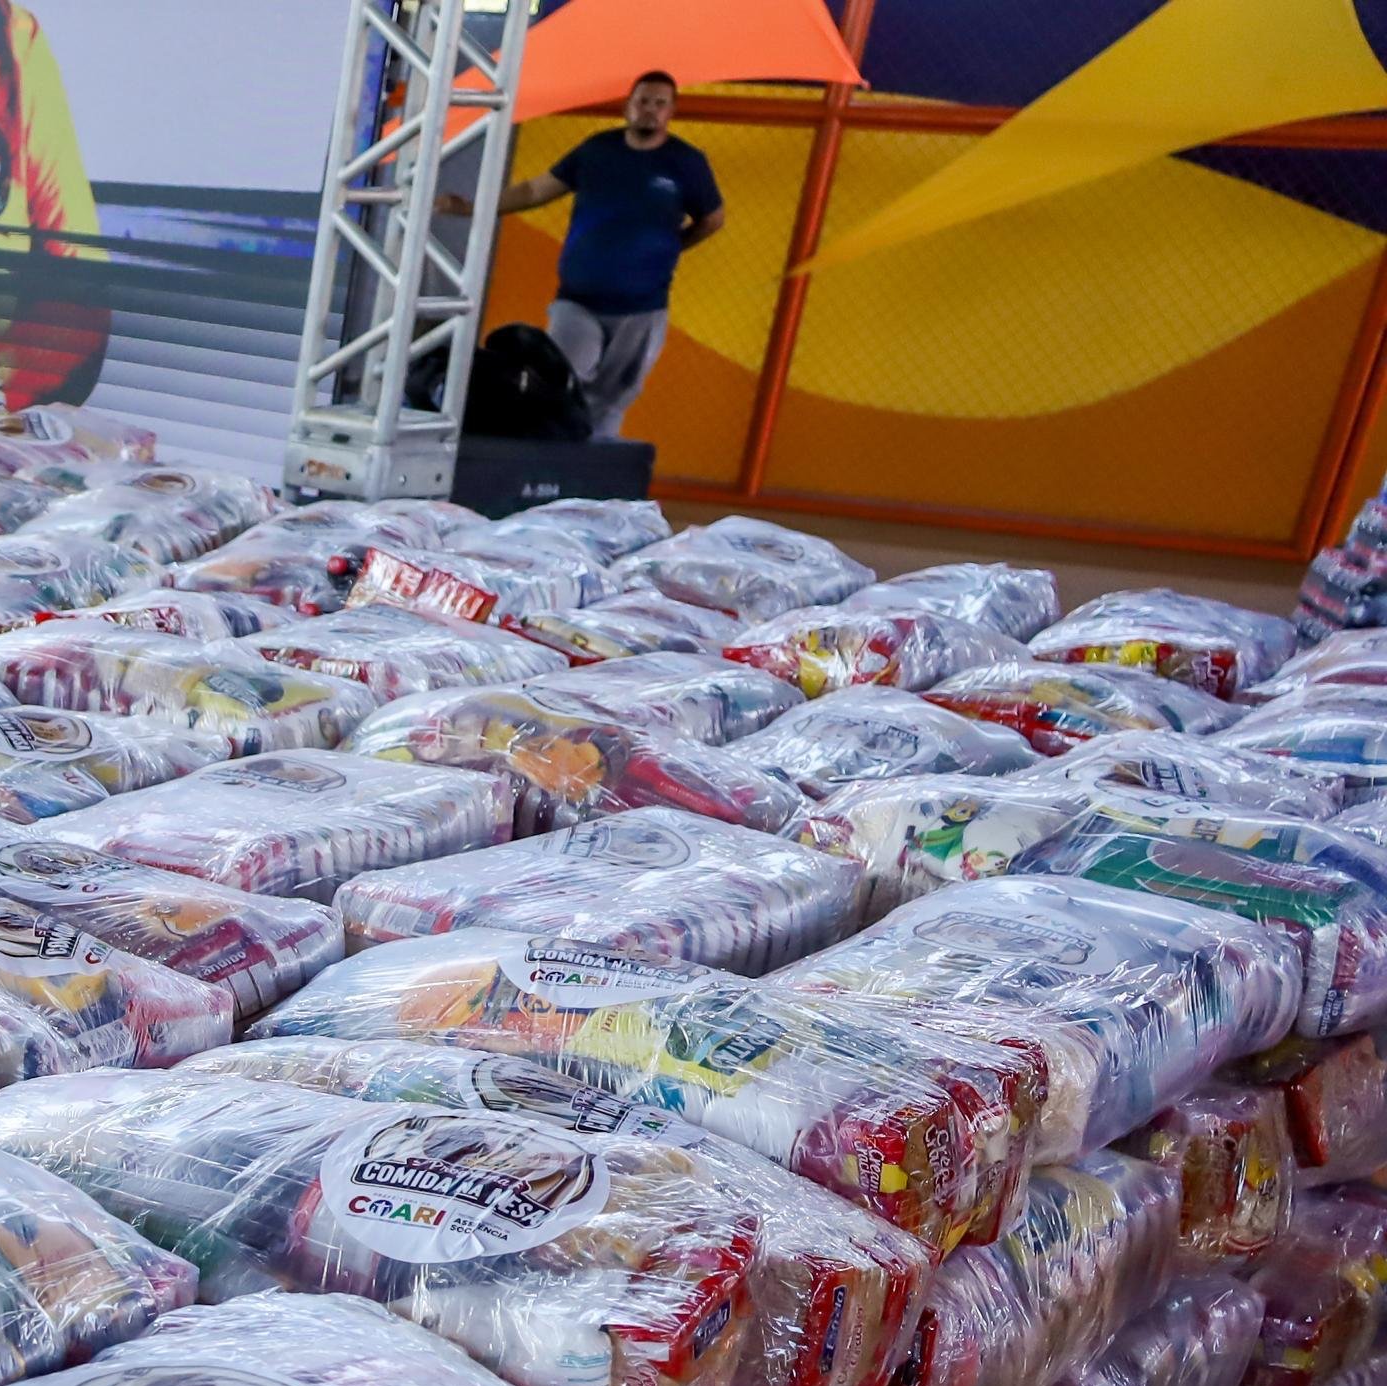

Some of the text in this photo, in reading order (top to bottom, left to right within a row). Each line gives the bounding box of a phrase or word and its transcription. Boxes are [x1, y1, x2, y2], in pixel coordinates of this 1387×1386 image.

[533, 949, 608, 969] COMIDA
[609, 959, 632, 973] NA
[530, 969, 610, 987] COARI
[362, 1161, 453, 1195] COMIDA
[348, 1194, 447, 1228] COARI
